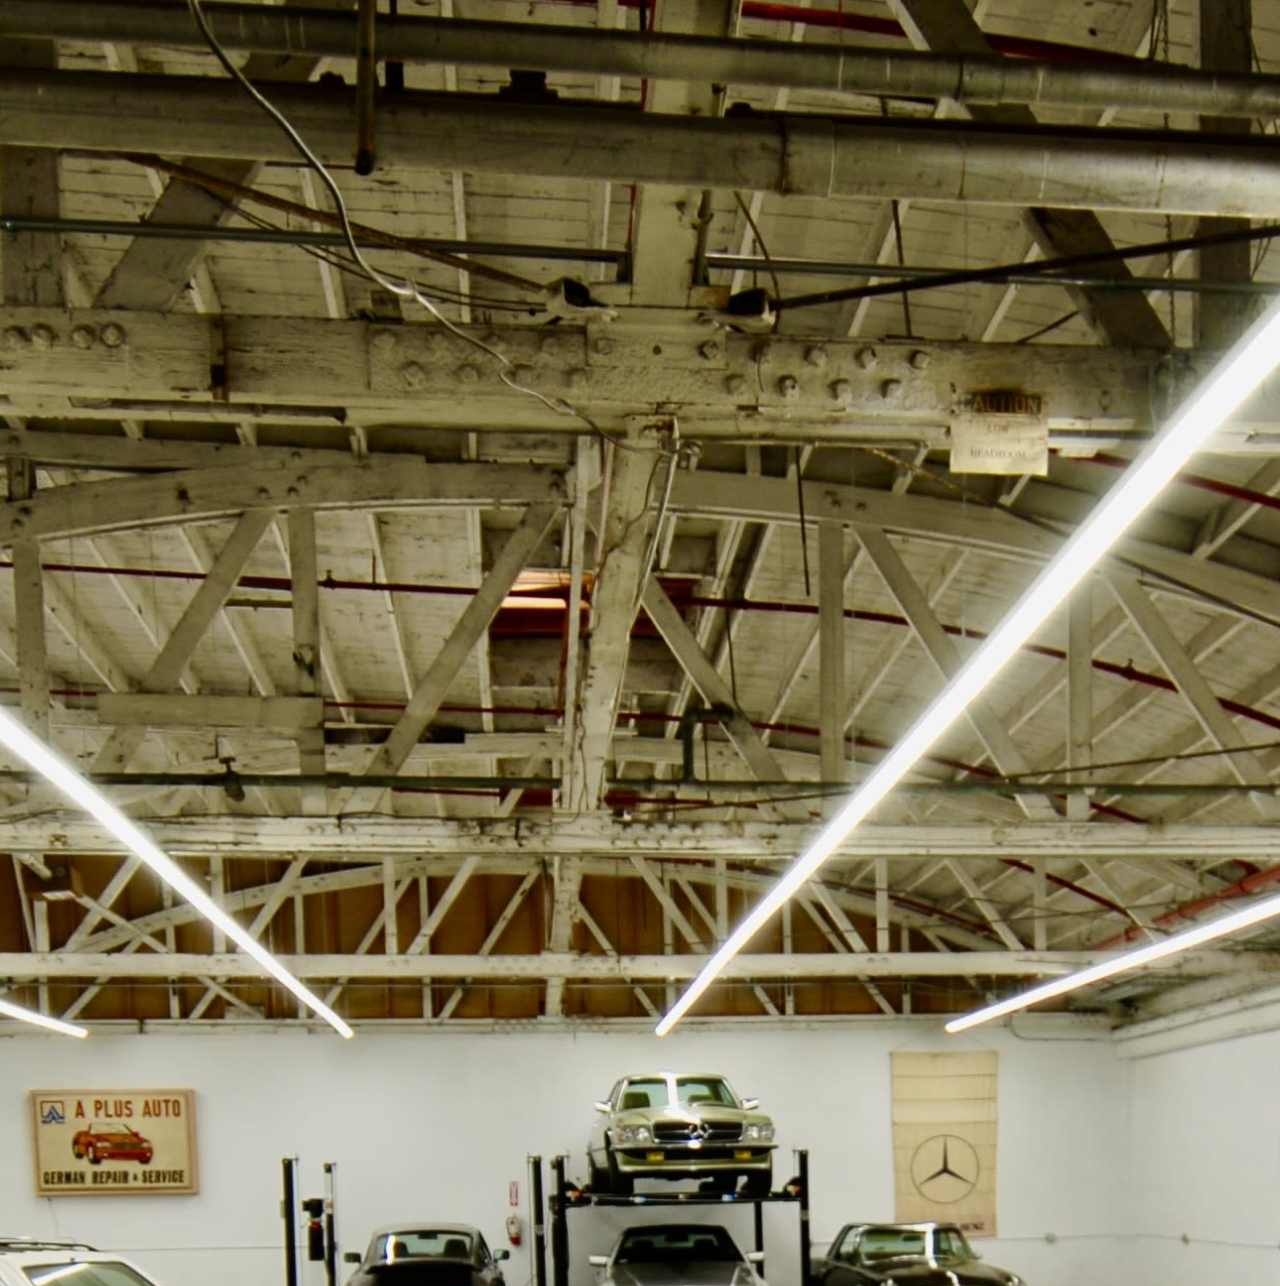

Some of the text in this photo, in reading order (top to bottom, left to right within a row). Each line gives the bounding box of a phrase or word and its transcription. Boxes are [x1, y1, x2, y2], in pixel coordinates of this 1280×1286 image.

[75, 1099, 181, 1119] A PLUS AUTO
[43, 1170, 86, 1186] GERMAN
[92, 1170, 129, 1185] REPAIR
[141, 1169, 185, 1184] SERVICE
